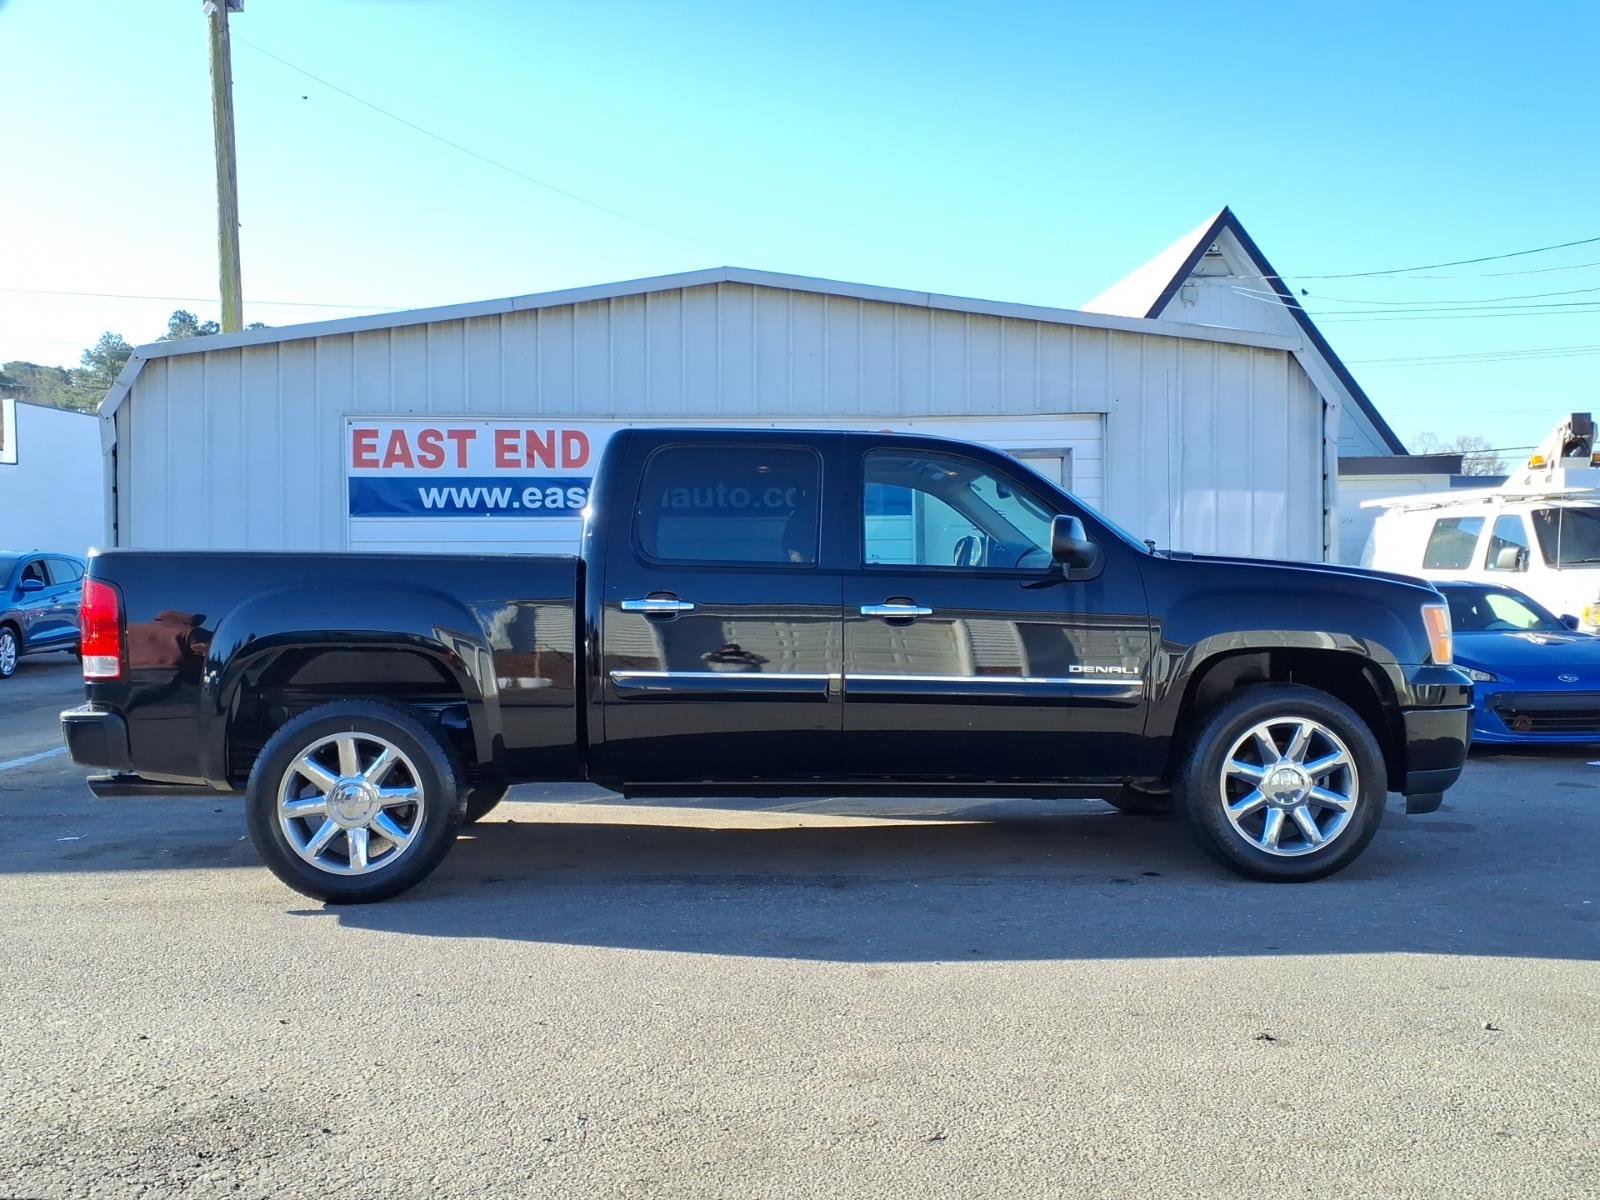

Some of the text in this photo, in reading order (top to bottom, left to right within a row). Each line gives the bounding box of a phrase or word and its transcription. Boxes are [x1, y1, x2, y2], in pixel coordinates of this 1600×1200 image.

[353, 428, 590, 469] EAST END
[418, 487, 590, 509] www.eas
[1069, 665, 1139, 674] DENALI
